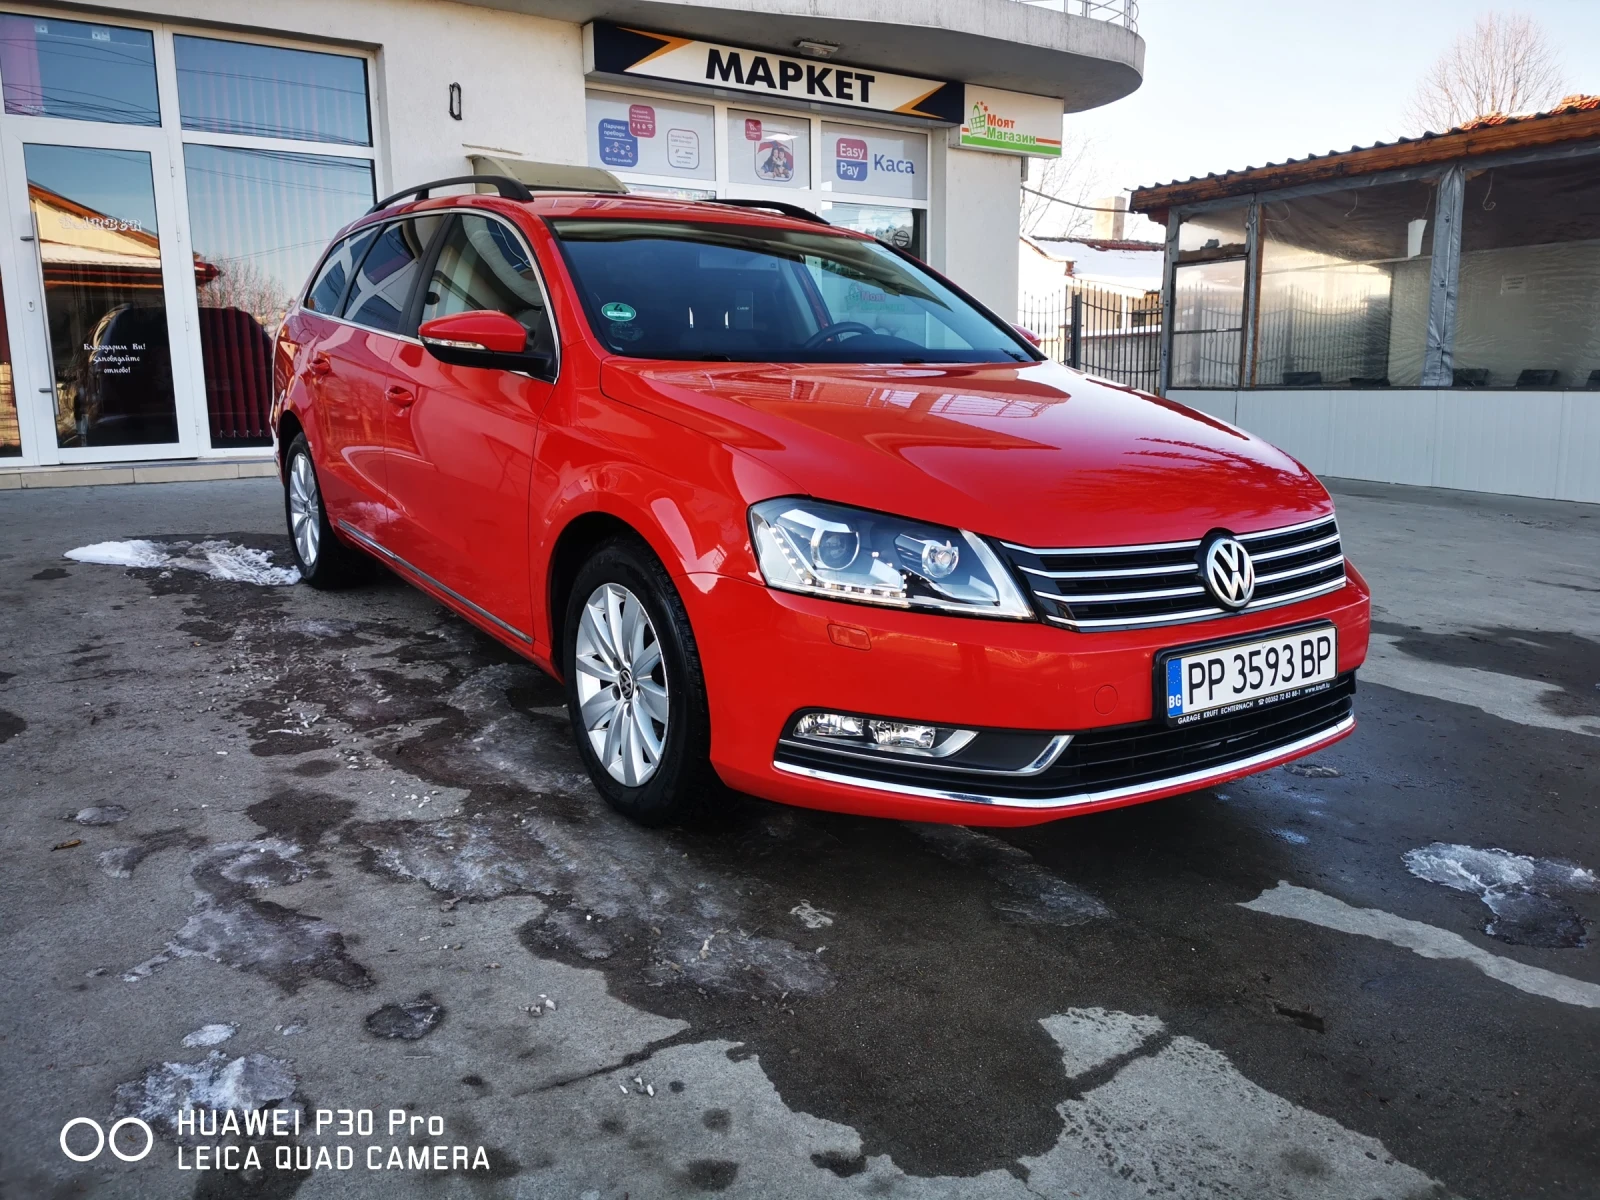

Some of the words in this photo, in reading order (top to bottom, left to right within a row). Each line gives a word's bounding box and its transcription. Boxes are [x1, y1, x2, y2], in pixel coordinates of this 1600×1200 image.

[706, 48, 875, 103] МАРКЕТ
[987, 114, 1015, 129] Моят
[986, 127, 1036, 144] Магазин
[840, 143, 864, 159] Easy
[840, 162, 859, 178] Pay
[874, 154, 915, 174] Каса
[1188, 658, 1225, 705] PP
[1232, 643, 1295, 694] 3593
[1301, 635, 1331, 680] BP
[1168, 694, 1182, 709] BG
[1177, 713, 1201, 725] GARAGE
[1203, 710, 1219, 719] KRUFT
[1220, 701, 1254, 715] ECHTERNACH
